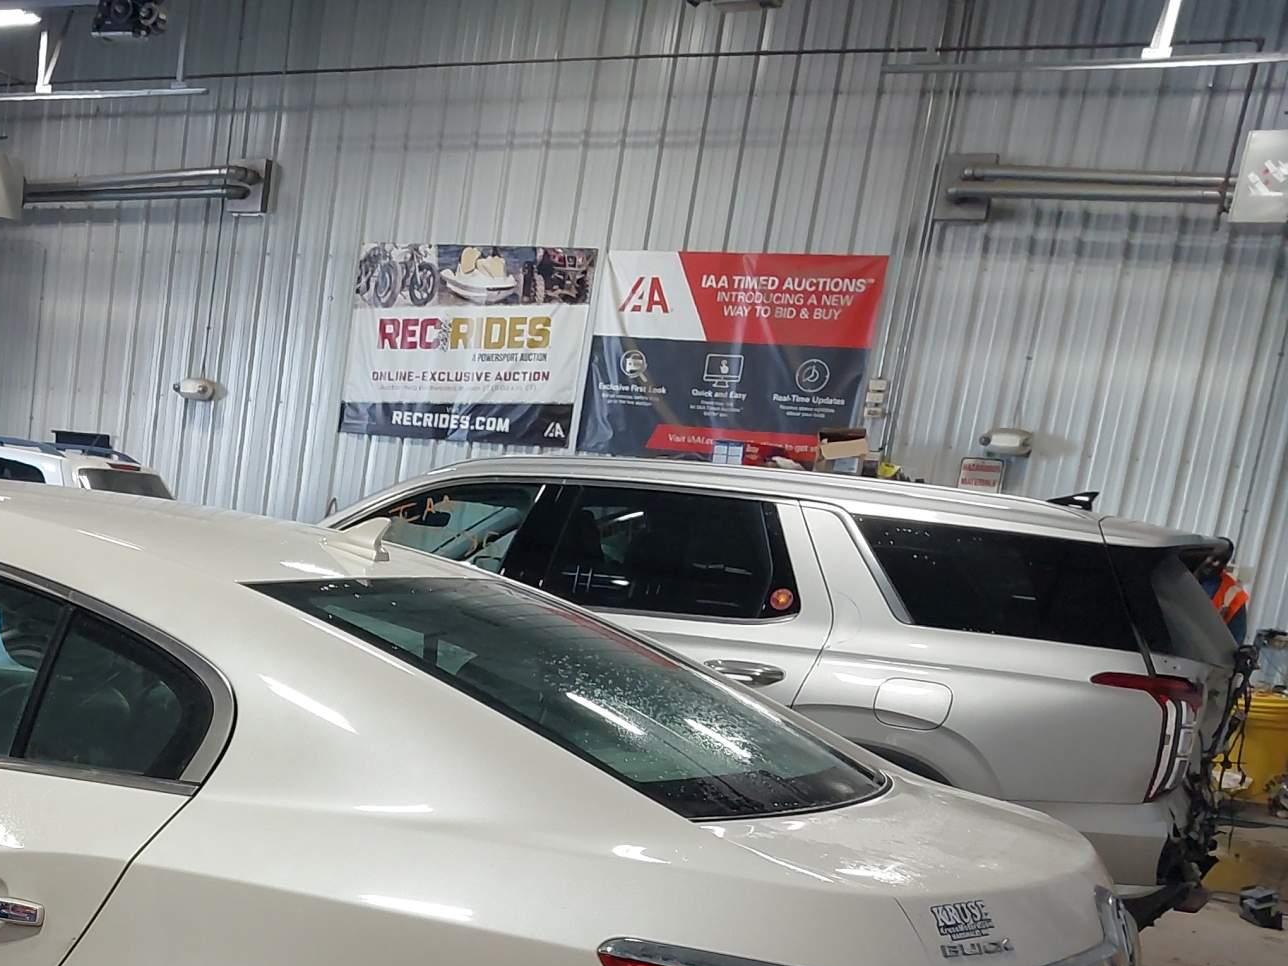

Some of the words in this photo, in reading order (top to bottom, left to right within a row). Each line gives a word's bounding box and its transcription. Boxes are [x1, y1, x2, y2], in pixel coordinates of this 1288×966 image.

[701, 274, 729, 289] IAA
[732, 275, 779, 290] TIMED
[716, 291, 805, 306] INTRODUCING
[807, 294, 817, 306] A
[820, 294, 853, 307] NEW
[723, 305, 752, 317] WAY
[755, 306, 770, 318] TO
[775, 307, 797, 319] BID
[799, 308, 809, 319] &
[813, 308, 842, 320] BUY
[520, 353, 548, 362] AUCTION
[371, 370, 491, 382] ONLINE-EXCLUSIVE
[494, 370, 550, 382] AUCTION
[691, 388, 713, 398] Quick
[729, 390, 748, 401] Easy
[772, 393, 811, 403] Real-Time
[812, 395, 845, 406] Updates
[391, 410, 511, 432] RECRIDES.COM
